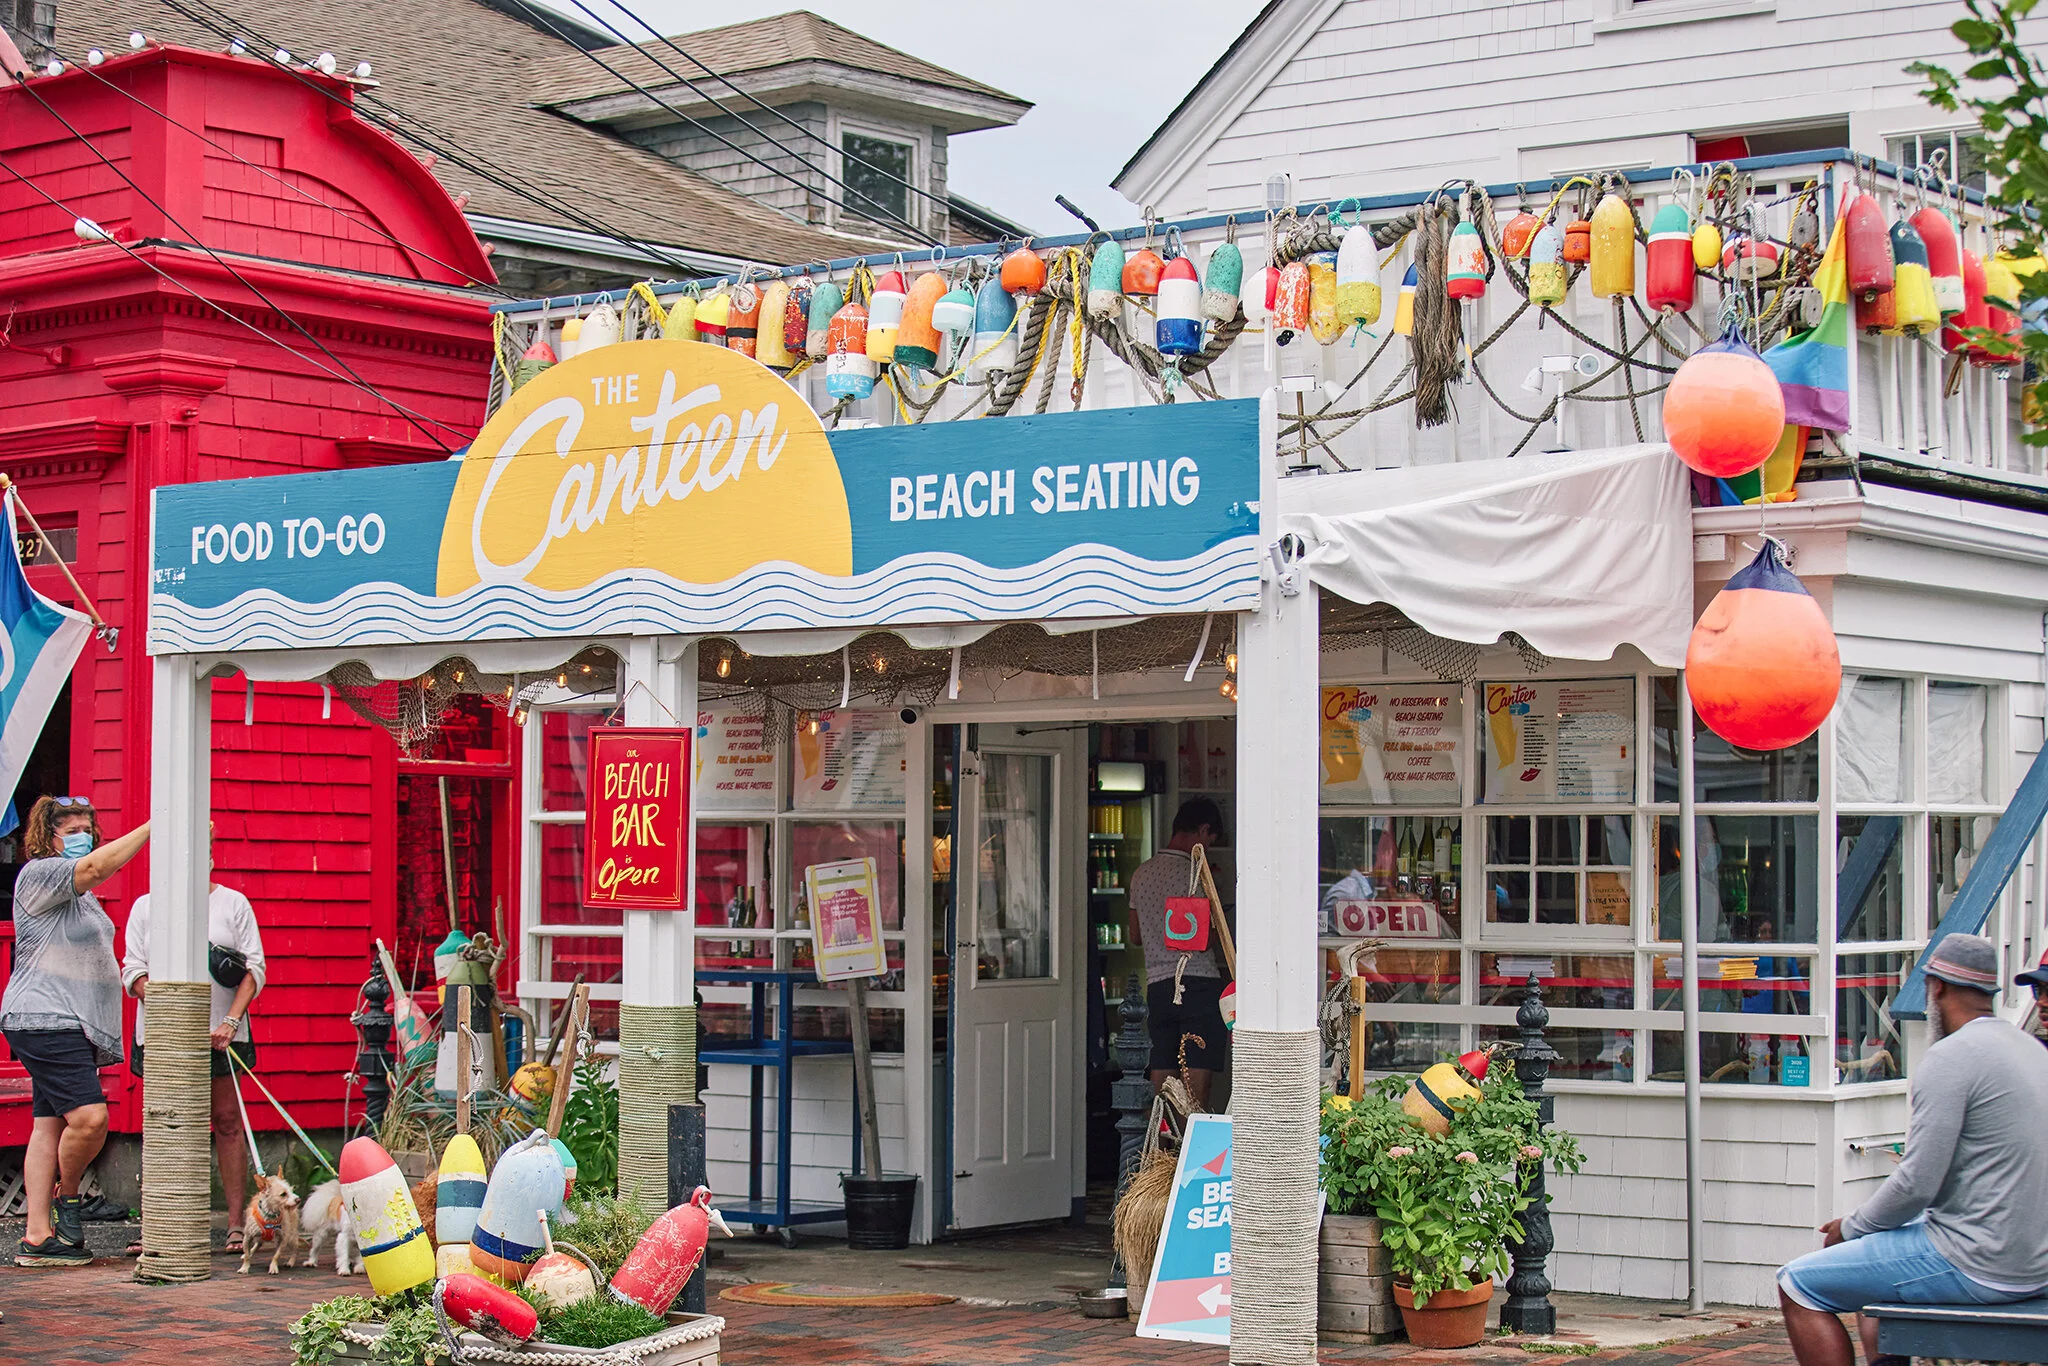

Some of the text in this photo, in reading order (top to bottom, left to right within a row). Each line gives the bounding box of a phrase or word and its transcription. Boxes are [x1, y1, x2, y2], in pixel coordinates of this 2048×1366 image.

[592, 374, 639, 406] THE
[472, 369, 788, 580] Canteen
[890, 456, 1200, 522] BEACH SEATING
[192, 512, 386, 564] FOOD TO-GO
[1325, 689, 1379, 720] Canteen
[1390, 698, 1400, 706] NO
[1487, 684, 1537, 715] Canteen
[1395, 712, 1444, 721] BEACH SEATING
[1398, 726, 1441, 736] PET FRIENDLY
[1384, 772, 1456, 781] HOUSE MADE PASTRIES
[1408, 756, 1432, 766] COFFEE
[604, 762, 670, 800] BEACH
[612, 803, 666, 848] BAR
[625, 855, 633, 864] is
[598, 858, 660, 900] Open
